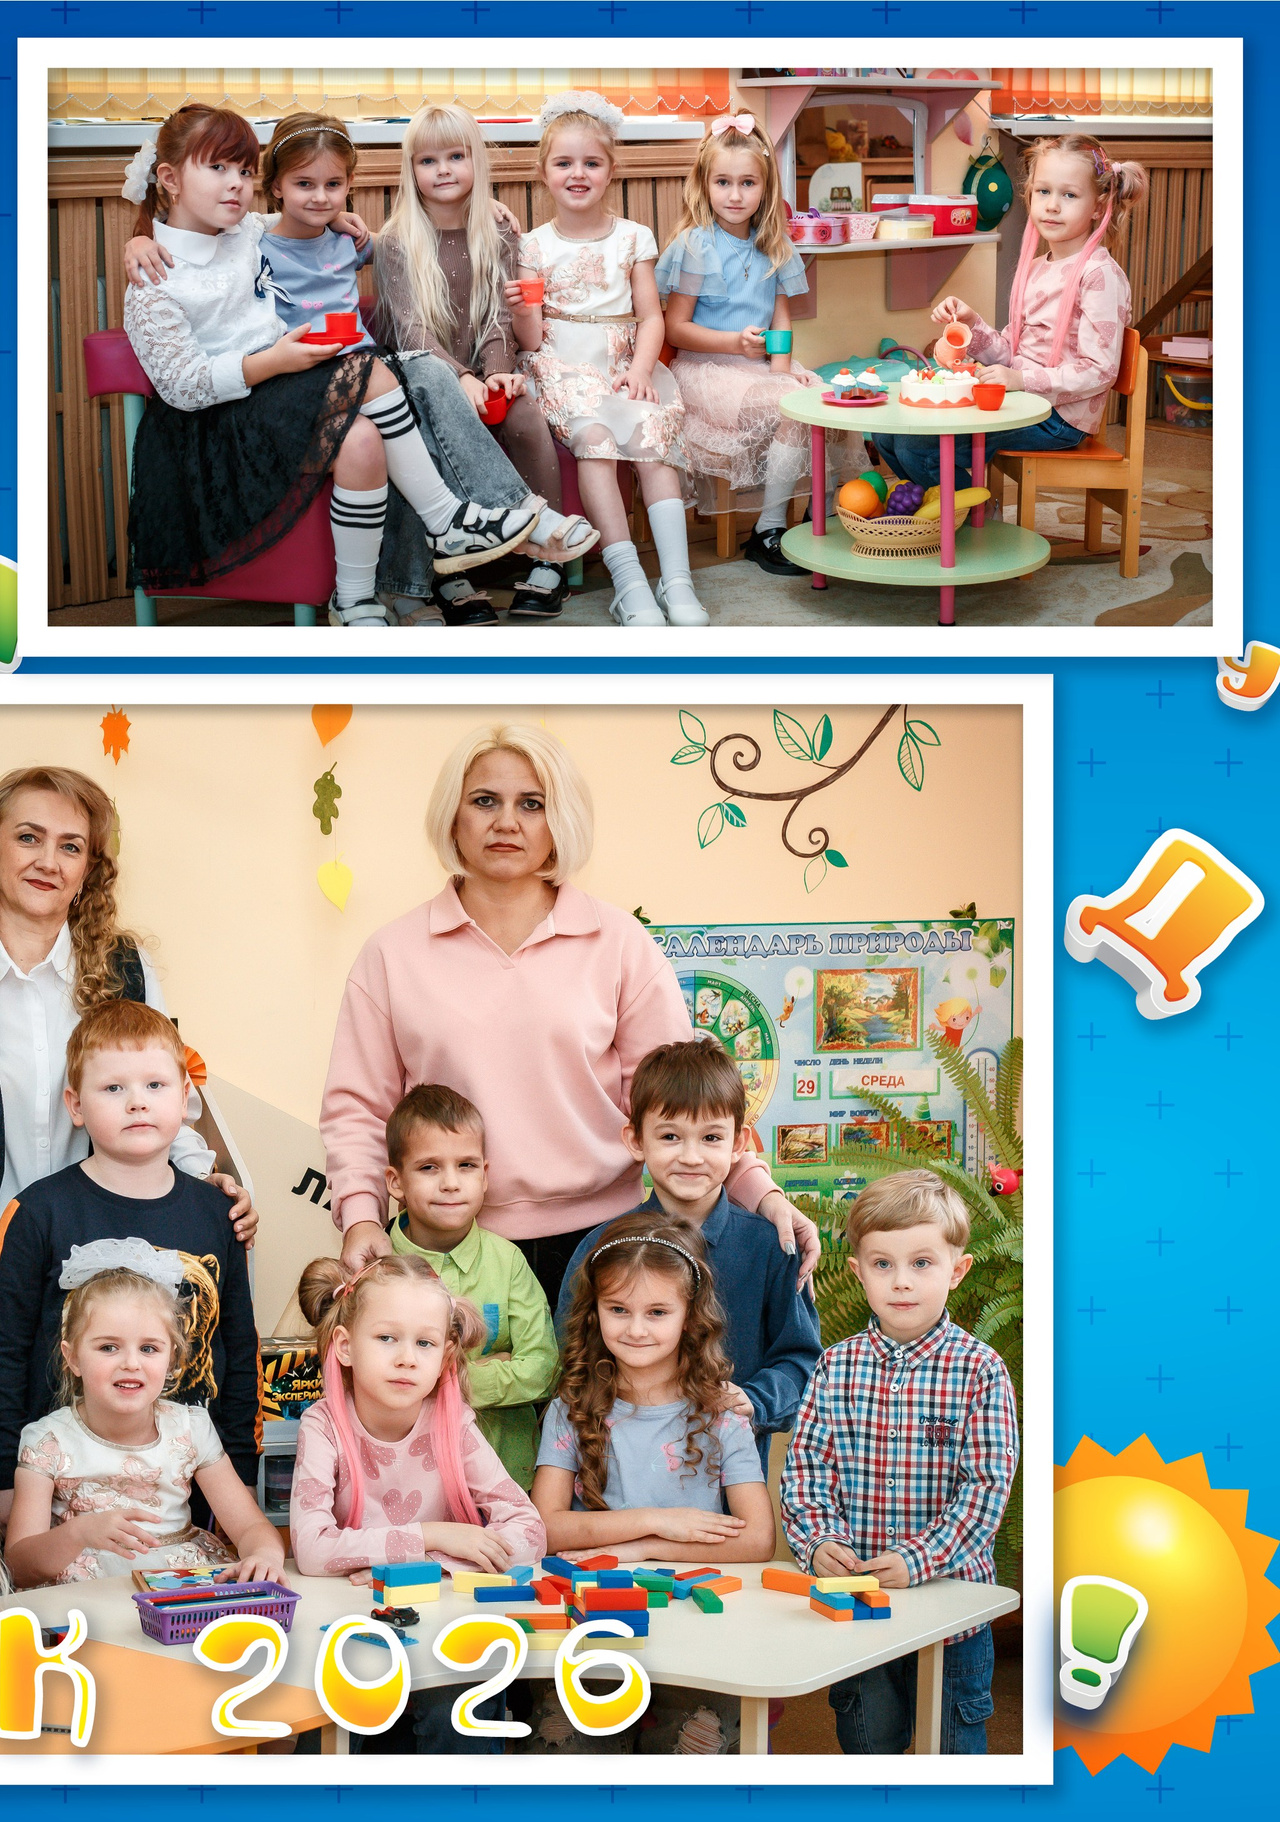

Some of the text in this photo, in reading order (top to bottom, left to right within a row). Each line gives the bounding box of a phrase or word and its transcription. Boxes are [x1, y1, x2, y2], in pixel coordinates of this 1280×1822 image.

[829, 930, 972, 955] ПРИРОДЫ
[744, 989, 762, 1009] ВЕСНА
[829, 1058, 850, 1066] ДЕНЬ
[796, 1079, 815, 1094] 29
[861, 1075, 906, 1088] СРЕДА
[849, 1109, 880, 1117] ВОКРУГ
[291, 1379, 323, 1391] ЯРКИ
[271, 1390, 326, 1402] ЭКСПЕРИМ
